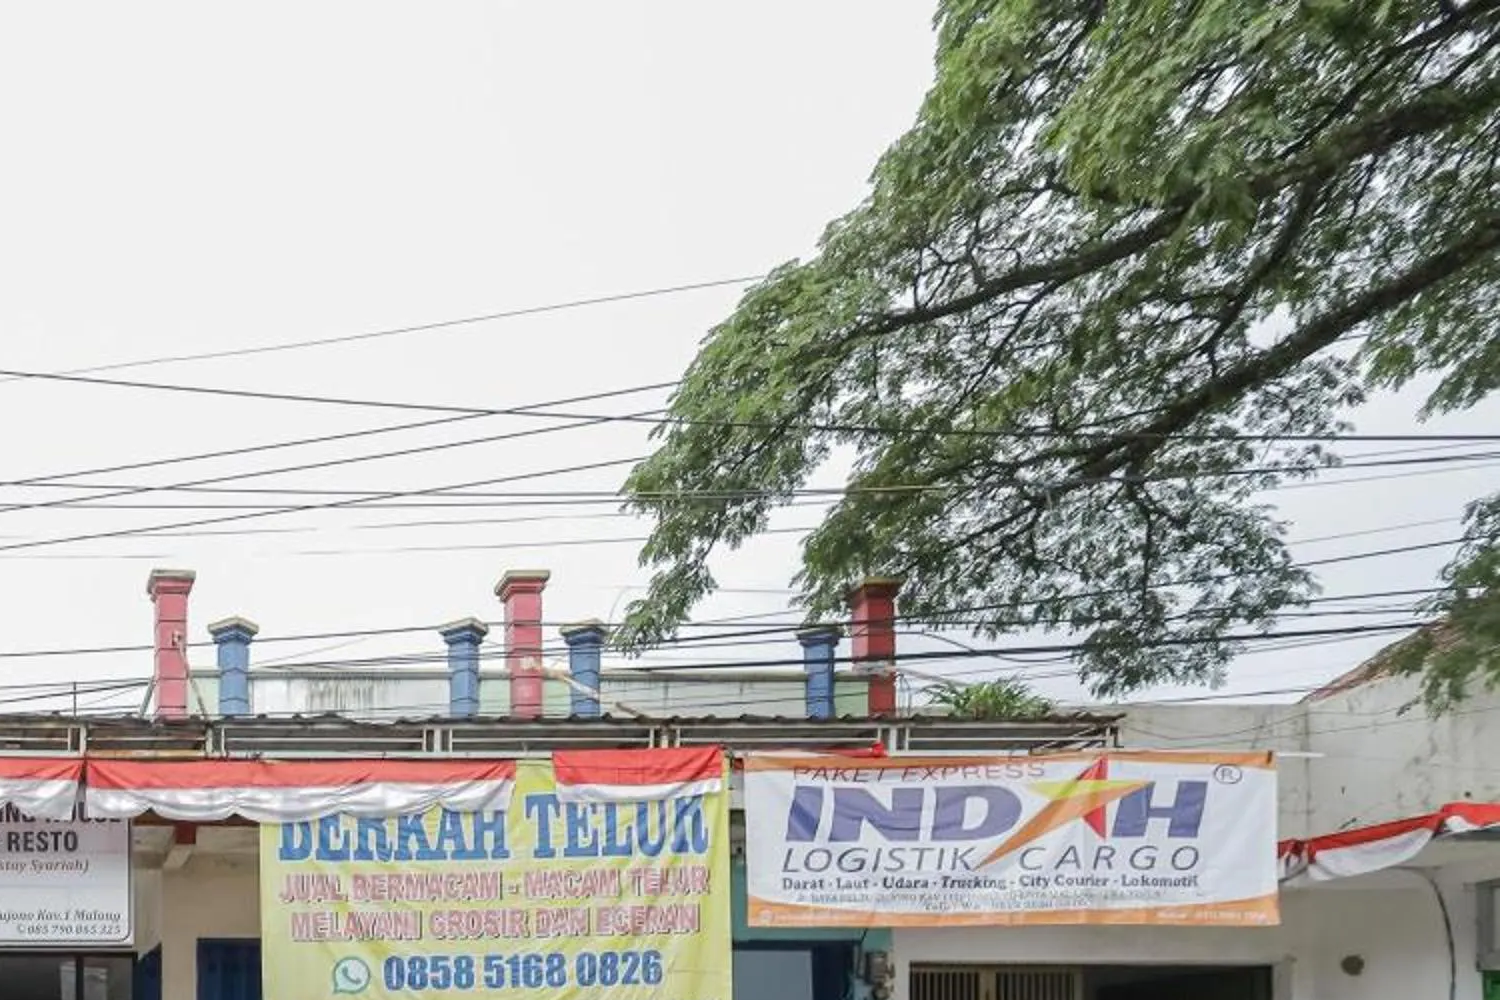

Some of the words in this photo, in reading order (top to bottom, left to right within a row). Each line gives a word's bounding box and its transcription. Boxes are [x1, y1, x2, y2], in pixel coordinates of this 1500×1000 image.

[902, 762, 1046, 782] EXPRESS
[6, 831, 79, 852] RESTO
[781, 845, 978, 874] LOGISTIK
[1019, 844, 1200, 872] CARGO
[279, 872, 349, 903] JUAL
[352, 870, 504, 902] BERMACAM
[523, 867, 623, 899] MACAM
[628, 864, 712, 896] TELUR
[782, 876, 824, 891] Darat
[836, 876, 869, 890] Laut
[882, 876, 929, 890] Udara
[941, 875, 1006, 890] Trucking
[1018, 874, 1051, 889] City
[1054, 874, 1108, 888] Courier
[1121, 874, 1199, 888] Lokomotif
[290, 910, 423, 943] MELAYANI
[428, 907, 530, 940] GROSIR
[534, 905, 591, 938] DAN
[595, 902, 702, 936] ECERAN
[383, 955, 475, 991] 0858
[483, 953, 567, 989] 5168
[575, 950, 663, 987] 0826
